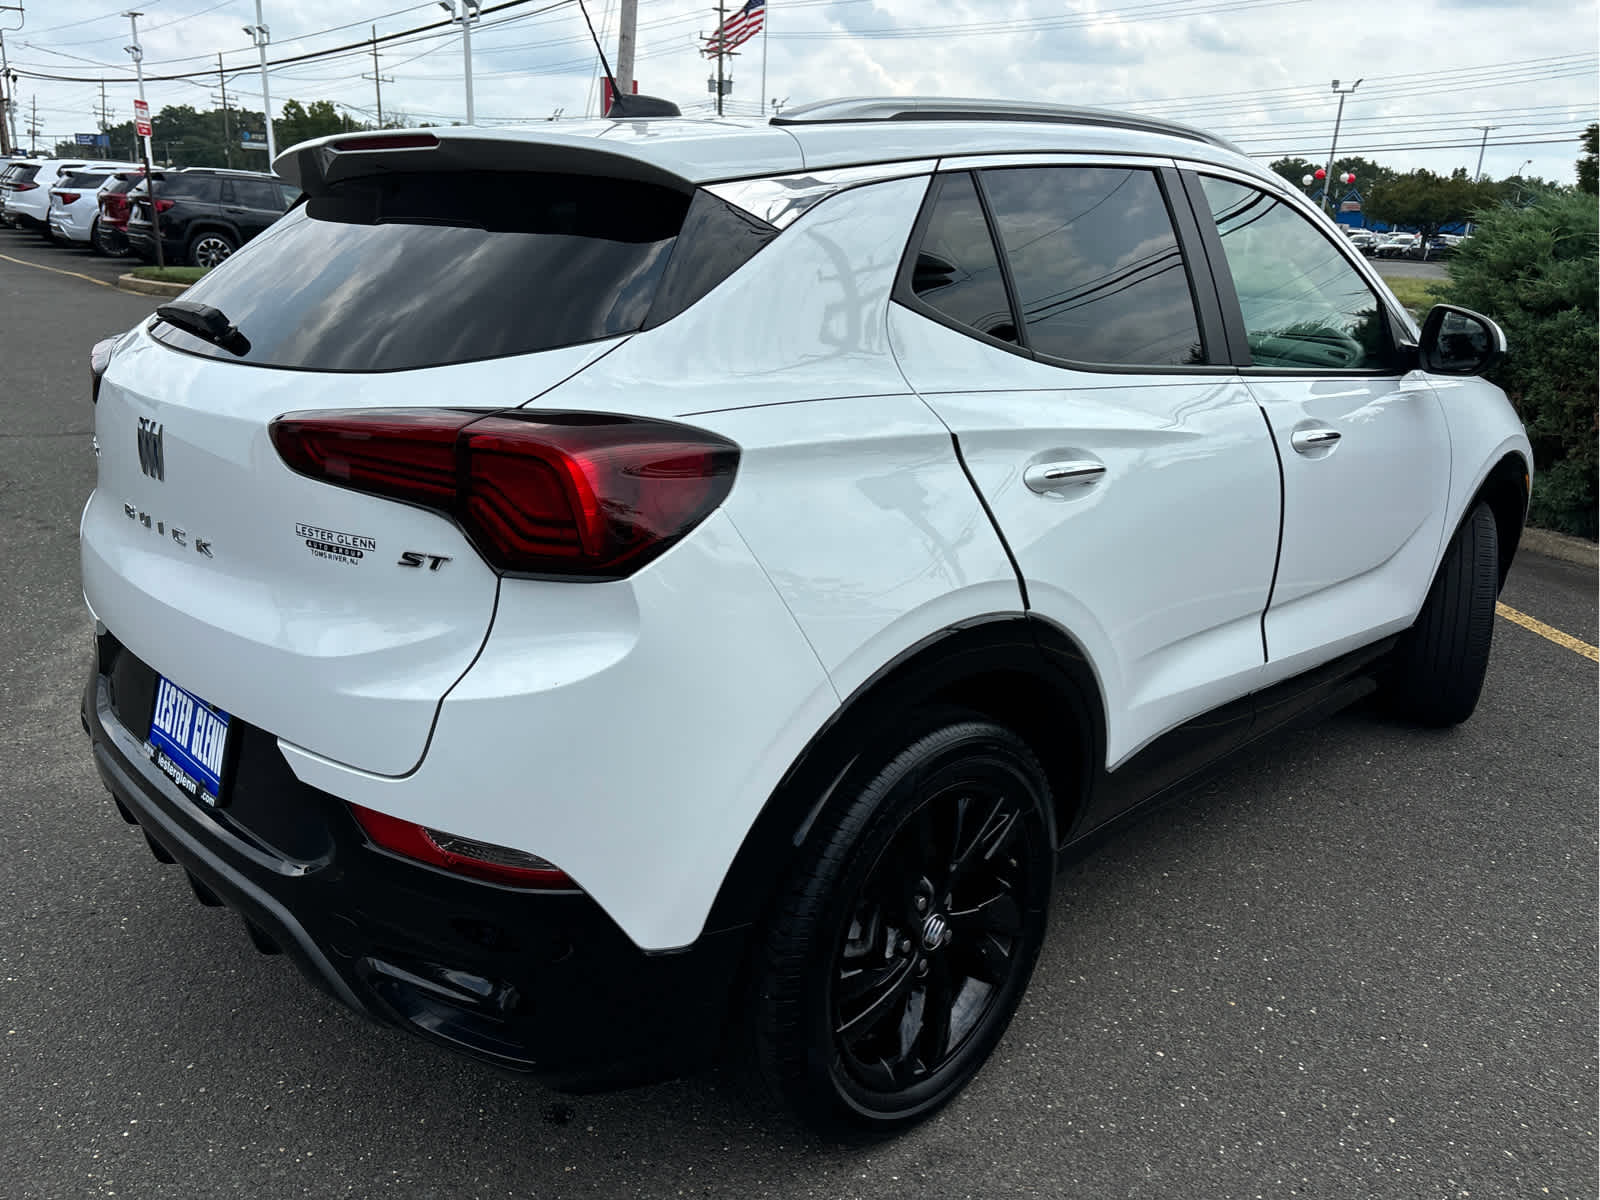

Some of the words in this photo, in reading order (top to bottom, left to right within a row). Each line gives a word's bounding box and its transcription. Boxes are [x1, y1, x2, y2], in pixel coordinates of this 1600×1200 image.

[124, 503, 213, 558] BUICK
[295, 525, 333, 541] LESTER
[337, 535, 376, 549] GLENN
[308, 541, 328, 550] AUTO
[332, 547, 361, 558] GROUP
[311, 550, 327, 559] TOMS
[350, 558, 359, 566] NJ
[398, 551, 453, 571] ST
[153, 678, 194, 750] LESTER
[191, 706, 228, 778] GLENN
[157, 752, 197, 794] lesterglenn
